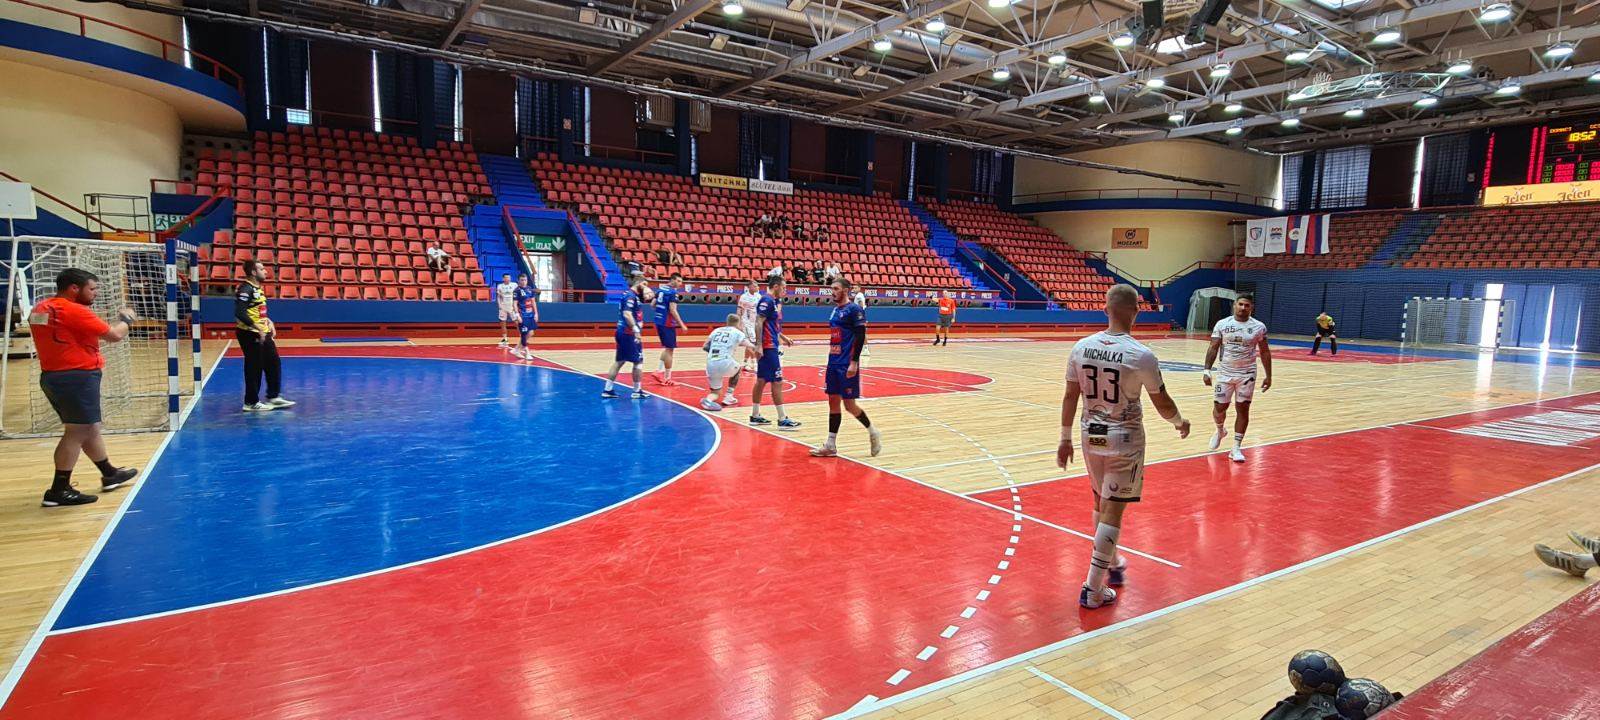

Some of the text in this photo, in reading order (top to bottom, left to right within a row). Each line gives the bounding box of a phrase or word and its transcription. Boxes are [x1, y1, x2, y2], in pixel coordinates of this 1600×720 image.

[1568, 131, 1597, 142] 18:52
[535, 242, 552, 251] IZLAZ
[716, 285, 734, 293] PRESS
[794, 287, 810, 295] PRESS
[864, 289, 878, 297] PRESS
[885, 289, 899, 297] PRESS
[713, 331, 730, 344] 22
[1083, 347, 1124, 364] MICHALKA
[1082, 364, 1120, 404] 33
